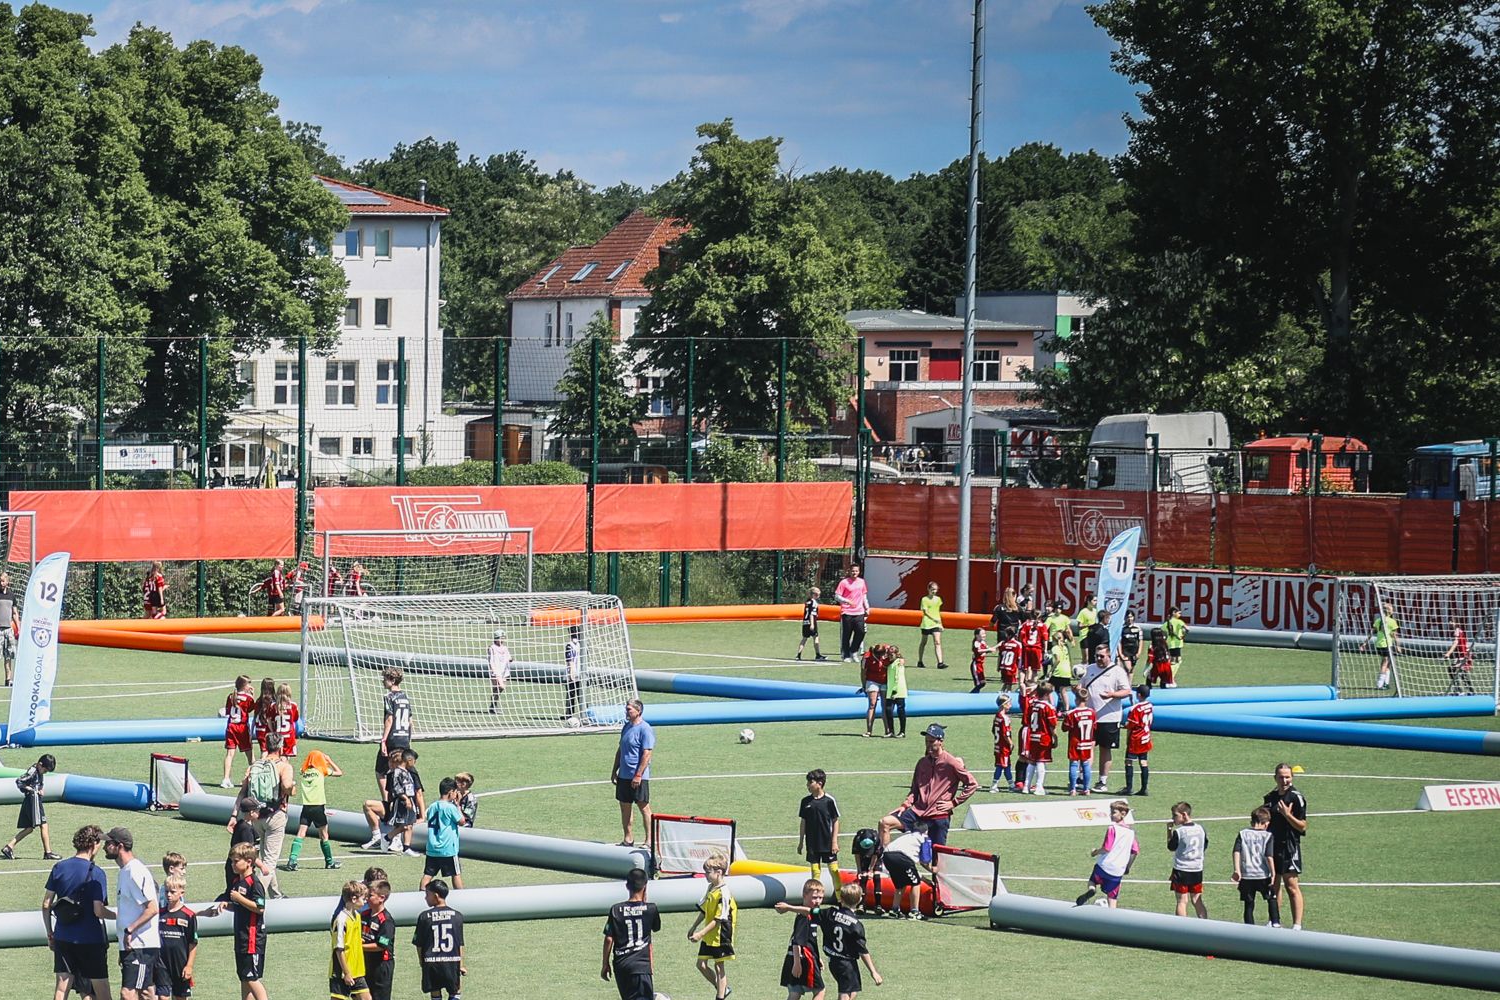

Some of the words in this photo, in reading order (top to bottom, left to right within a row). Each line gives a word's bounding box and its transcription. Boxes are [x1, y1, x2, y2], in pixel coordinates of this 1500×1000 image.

[458, 511, 509, 540] UNION
[1116, 556, 1128, 574] 11
[40, 581, 58, 603] 12
[1147, 575, 1234, 626] LIEBE
[1000, 650, 1015, 666] 10
[27, 653, 45, 728] AZOOKAGOAL
[275, 714, 291, 733] 15
[395, 707, 411, 731] 14
[1077, 718, 1093, 741] 17
[1445, 787, 1500, 808] EISERN
[431, 923, 454, 953] 15
[625, 918, 645, 948] 11
[832, 926, 844, 953] 3
